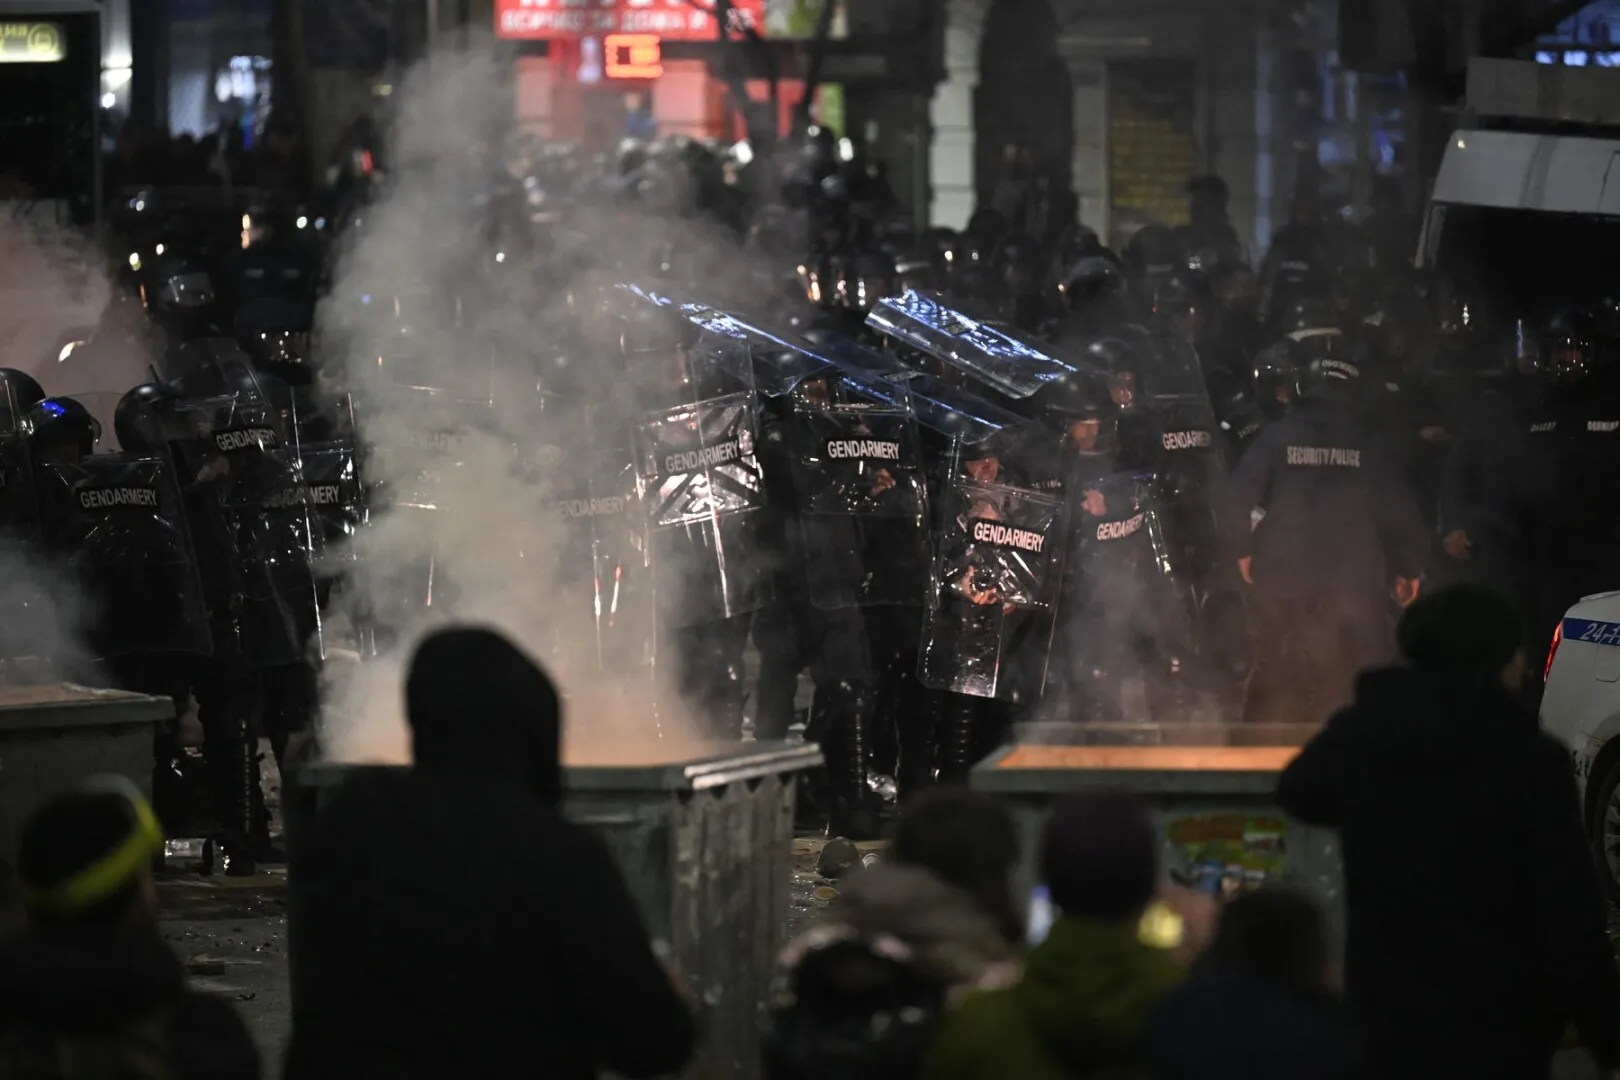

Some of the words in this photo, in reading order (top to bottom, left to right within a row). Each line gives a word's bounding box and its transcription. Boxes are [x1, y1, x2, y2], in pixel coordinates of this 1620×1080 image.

[665, 440, 738, 472] GENDARMERY
[828, 440, 899, 459] GENDARMERY
[1286, 445, 1329, 465] SECURITY
[1329, 447, 1361, 468] POLICE
[80, 487, 157, 508] GENDARMERY
[974, 522, 1045, 552] GENDARMERY
[1580, 623, 1620, 645] 24-1
